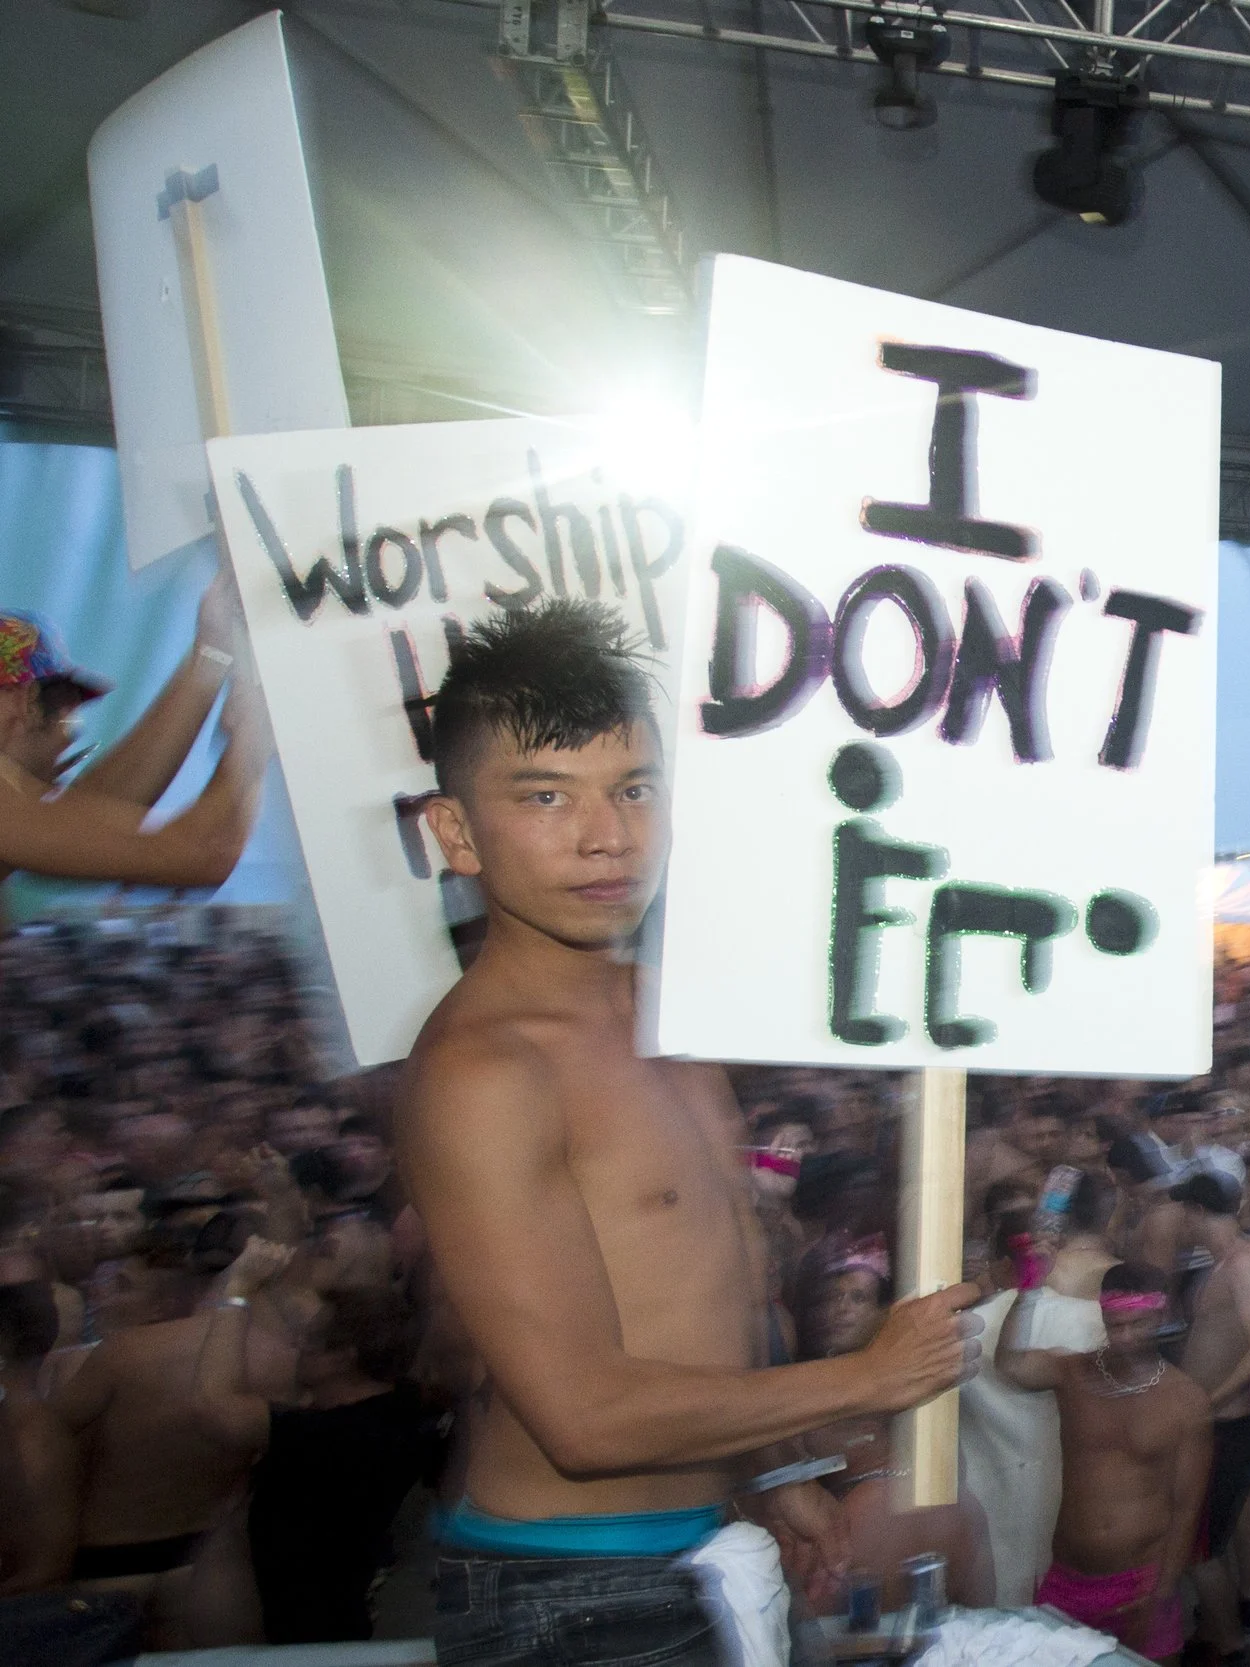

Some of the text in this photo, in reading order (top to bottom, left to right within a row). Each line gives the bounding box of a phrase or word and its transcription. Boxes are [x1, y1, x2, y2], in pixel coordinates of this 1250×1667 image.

[234, 445, 686, 652] Worship
[860, 339, 1039, 563] I
[697, 547, 1203, 774] DON'T
